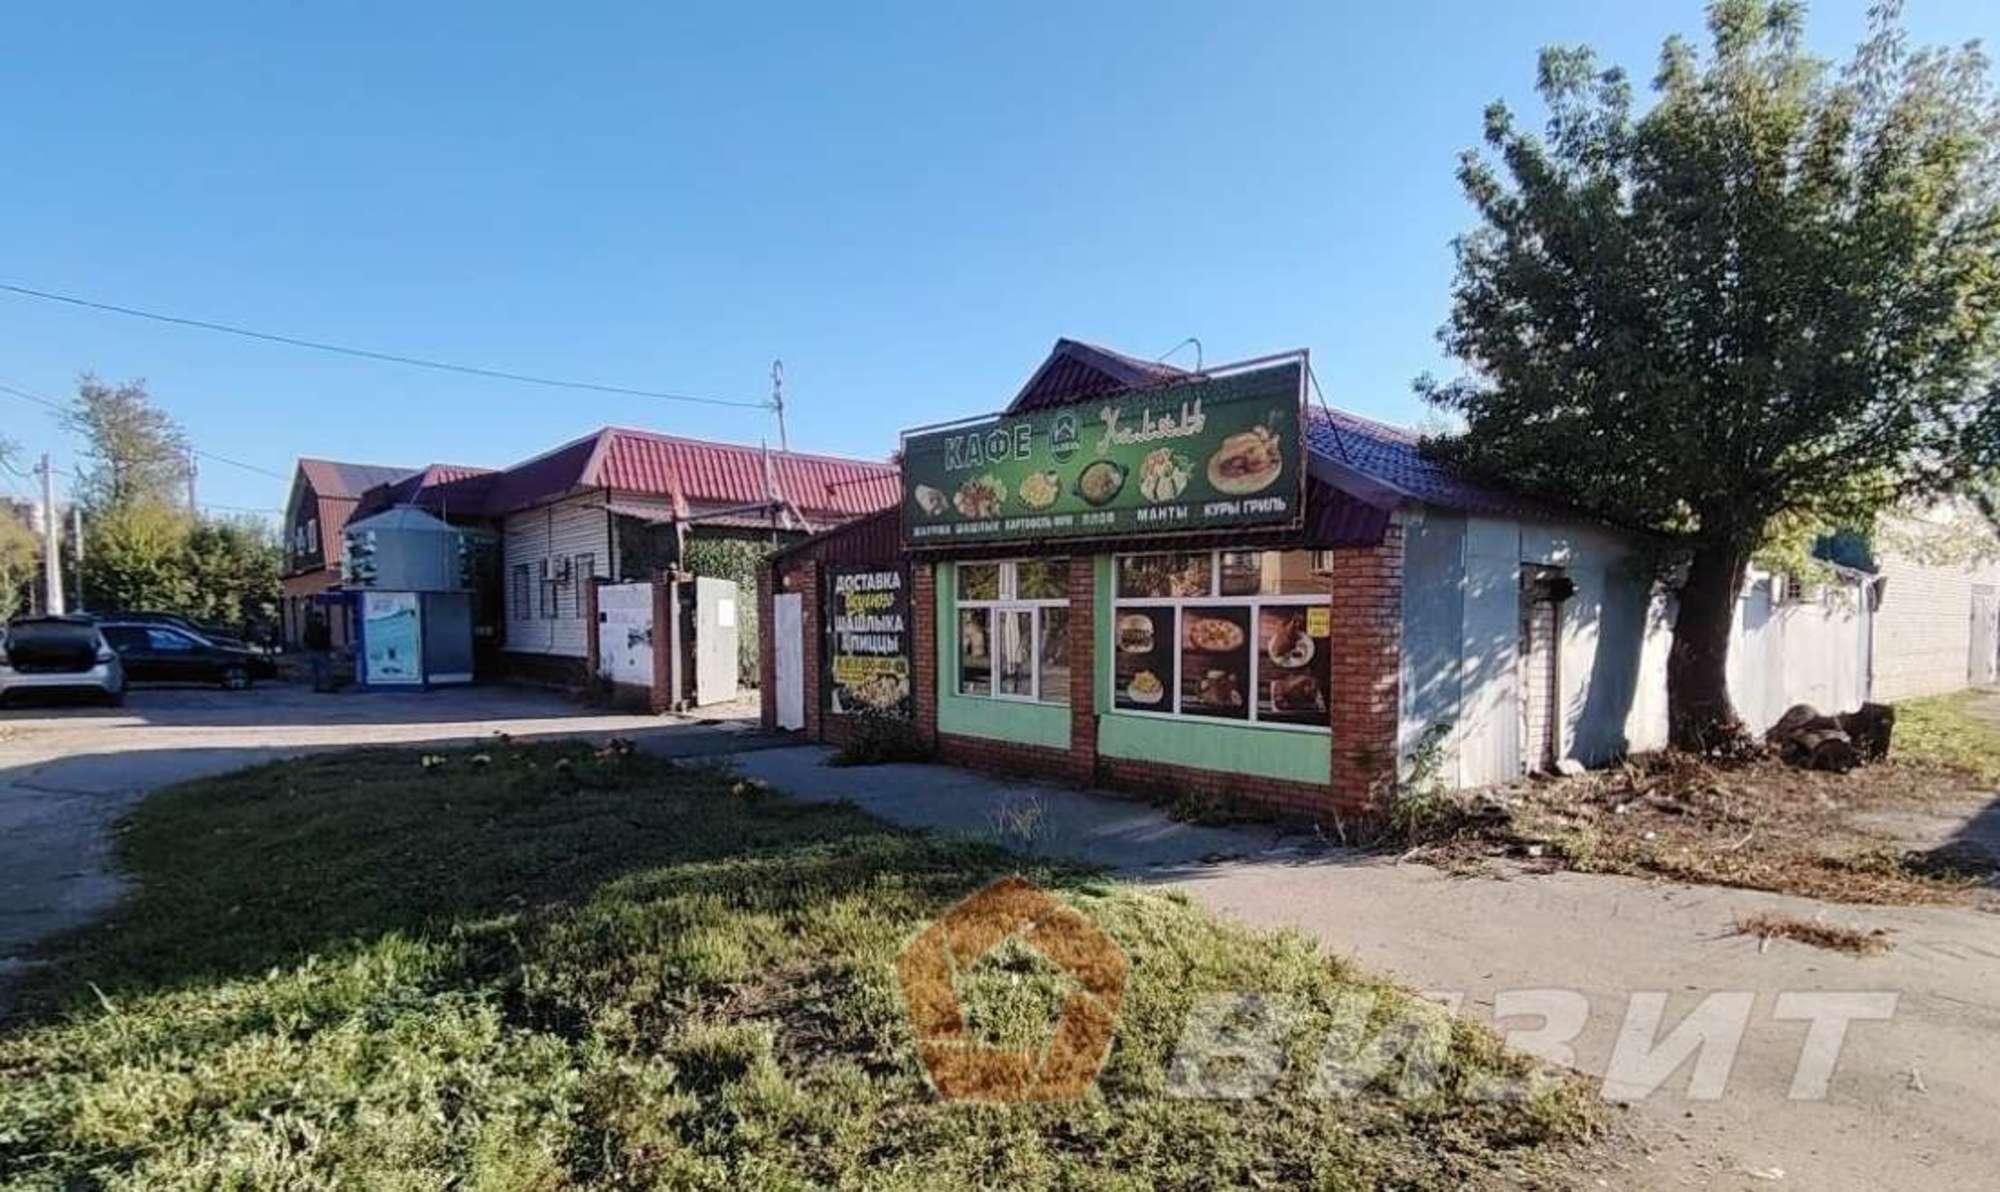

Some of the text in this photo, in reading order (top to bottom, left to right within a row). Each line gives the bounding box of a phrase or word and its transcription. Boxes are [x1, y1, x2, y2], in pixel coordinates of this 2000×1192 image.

[944, 424, 1032, 470] КАФЕ
[1137, 506, 1188, 522] МАНТЫ
[1204, 497, 1286, 517] КУРЫ ГРИЛЬ
[835, 571, 901, 594] ДОСТАВКА
[835, 614, 904, 633] ШАШЛЫКА
[850, 634, 899, 655] ПИЦЦЫ
